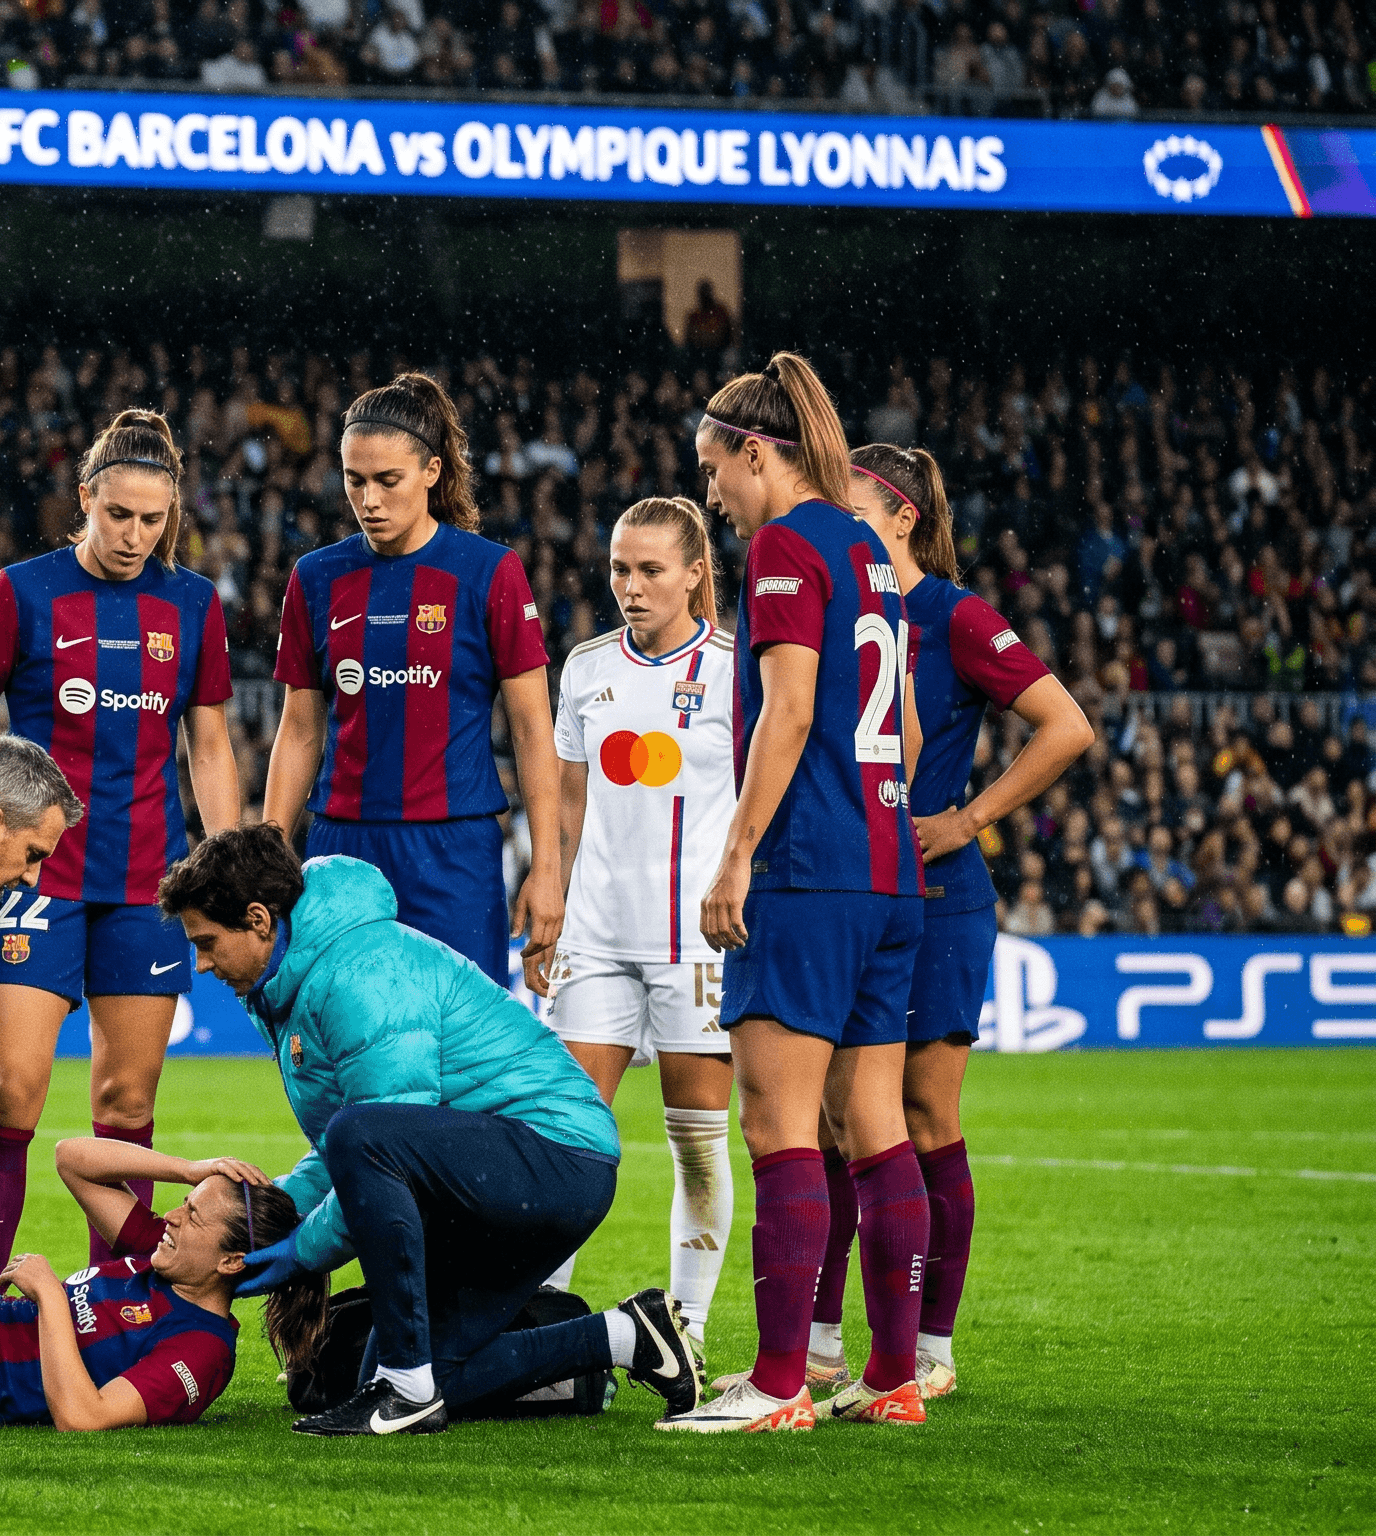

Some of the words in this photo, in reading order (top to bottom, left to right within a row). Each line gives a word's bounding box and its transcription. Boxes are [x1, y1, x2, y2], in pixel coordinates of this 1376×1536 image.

[68, 110, 386, 175] BARCELONA
[452, 122, 751, 186] OLYMPIQUE
[760, 131, 1006, 191] LYONNAIS
[369, 664, 442, 689] Spotify
[100, 688, 170, 715] Spotify
[675, 694, 700, 710] OL
[1115, 952, 1376, 1040] PS5
[70, 1284, 98, 1335] Spotify
